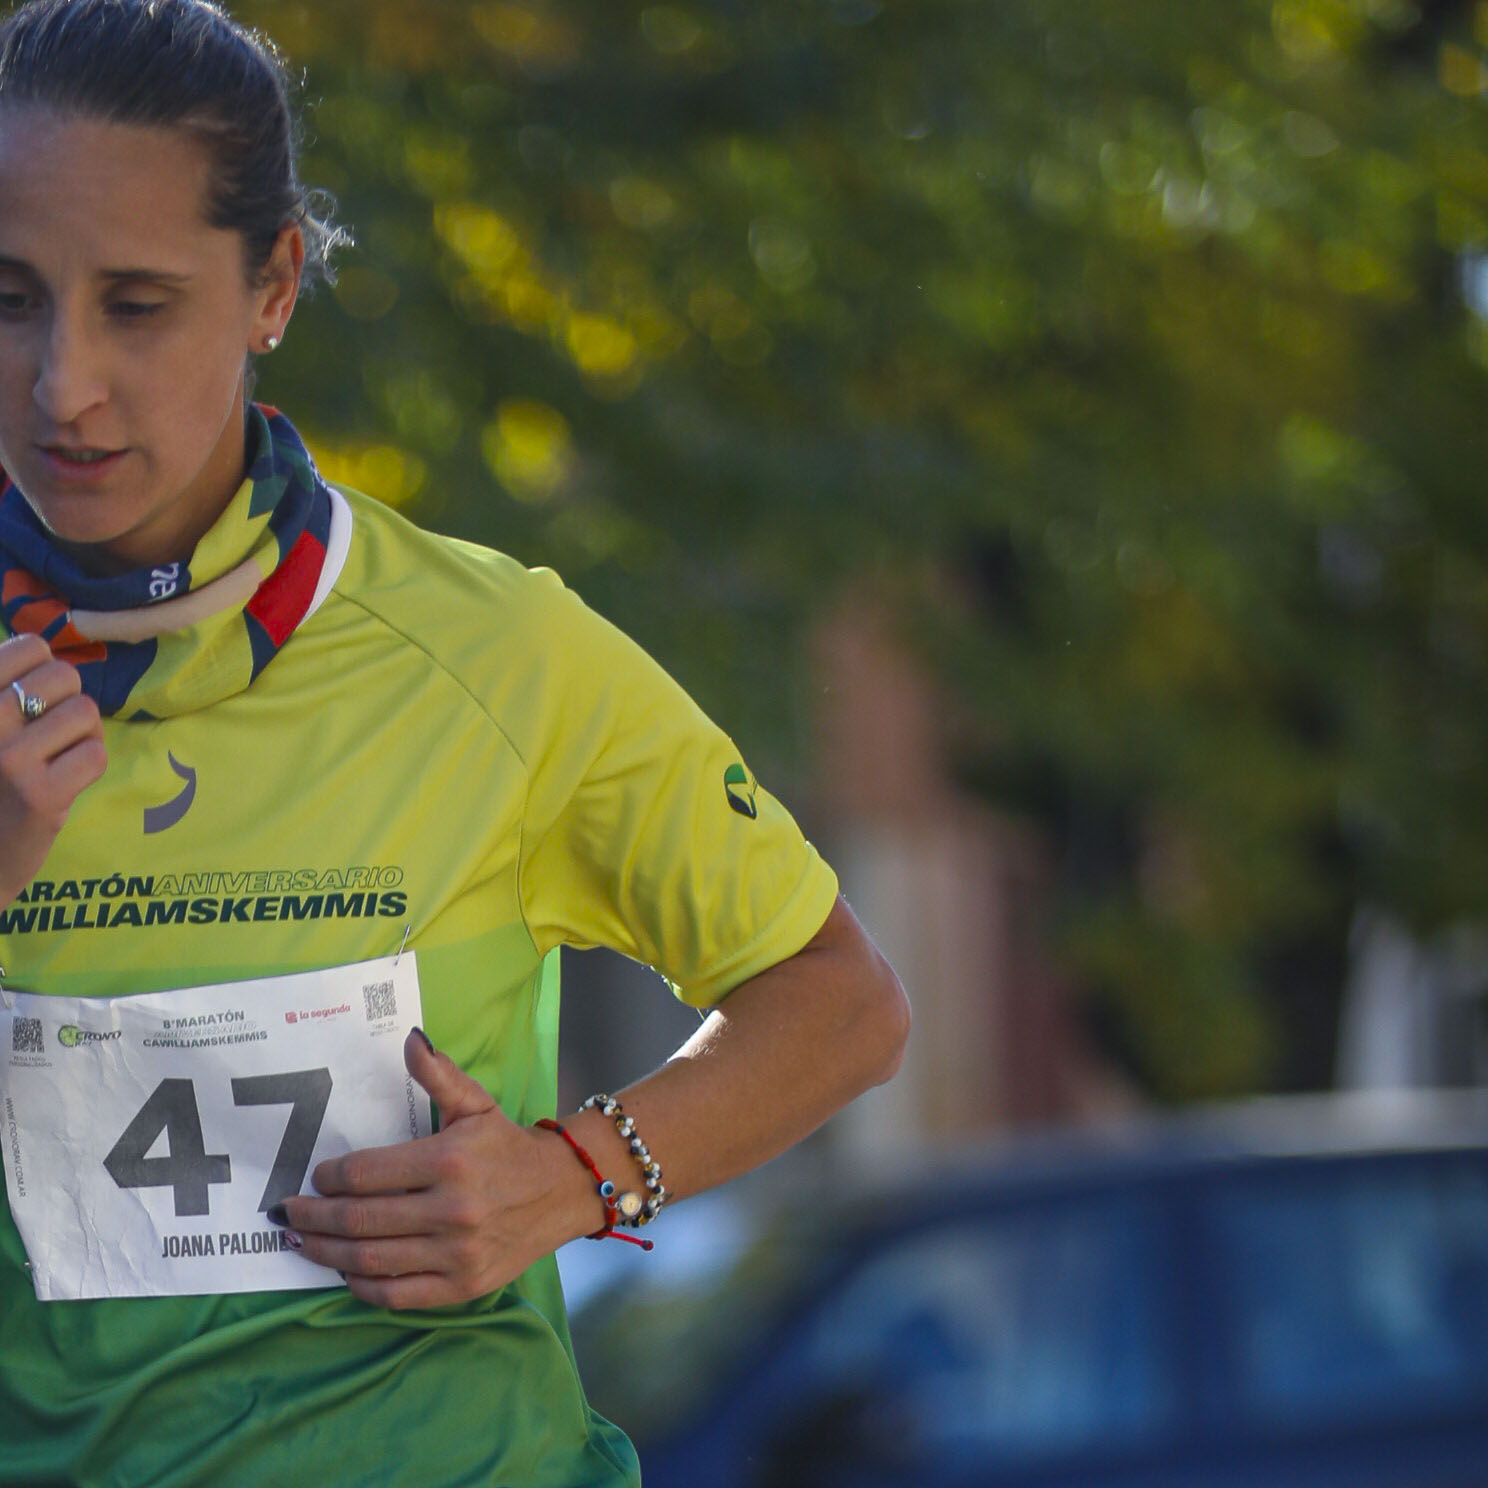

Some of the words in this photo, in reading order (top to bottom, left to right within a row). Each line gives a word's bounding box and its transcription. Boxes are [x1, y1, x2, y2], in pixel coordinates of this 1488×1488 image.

[103, 1067, 333, 1217] 47
[162, 1234, 215, 1258] JOANA
[219, 1229, 292, 1255] PALOME
